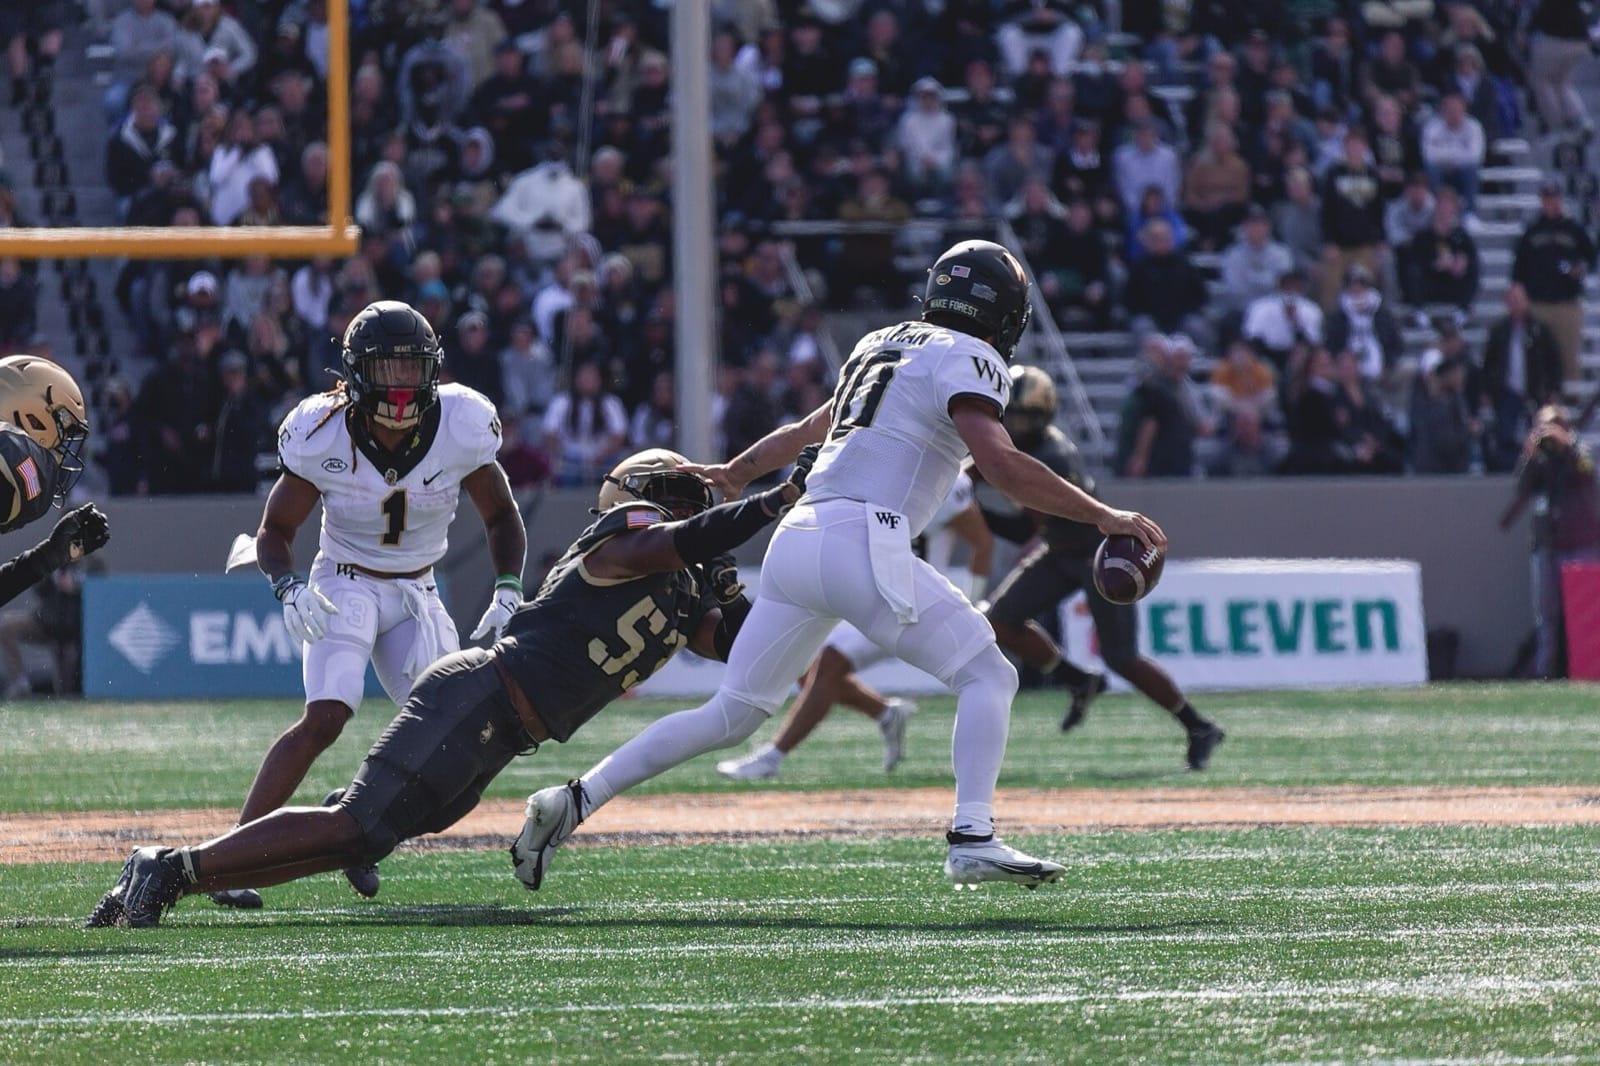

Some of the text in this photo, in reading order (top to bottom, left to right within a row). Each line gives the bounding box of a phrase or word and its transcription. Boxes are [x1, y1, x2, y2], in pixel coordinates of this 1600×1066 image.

[930, 299, 979, 318] WAKE FOREST
[831, 350, 902, 440] 10
[970, 356, 1006, 393] WF
[380, 487, 408, 546] 1
[875, 511, 901, 530] WF
[189, 611, 302, 664] EM
